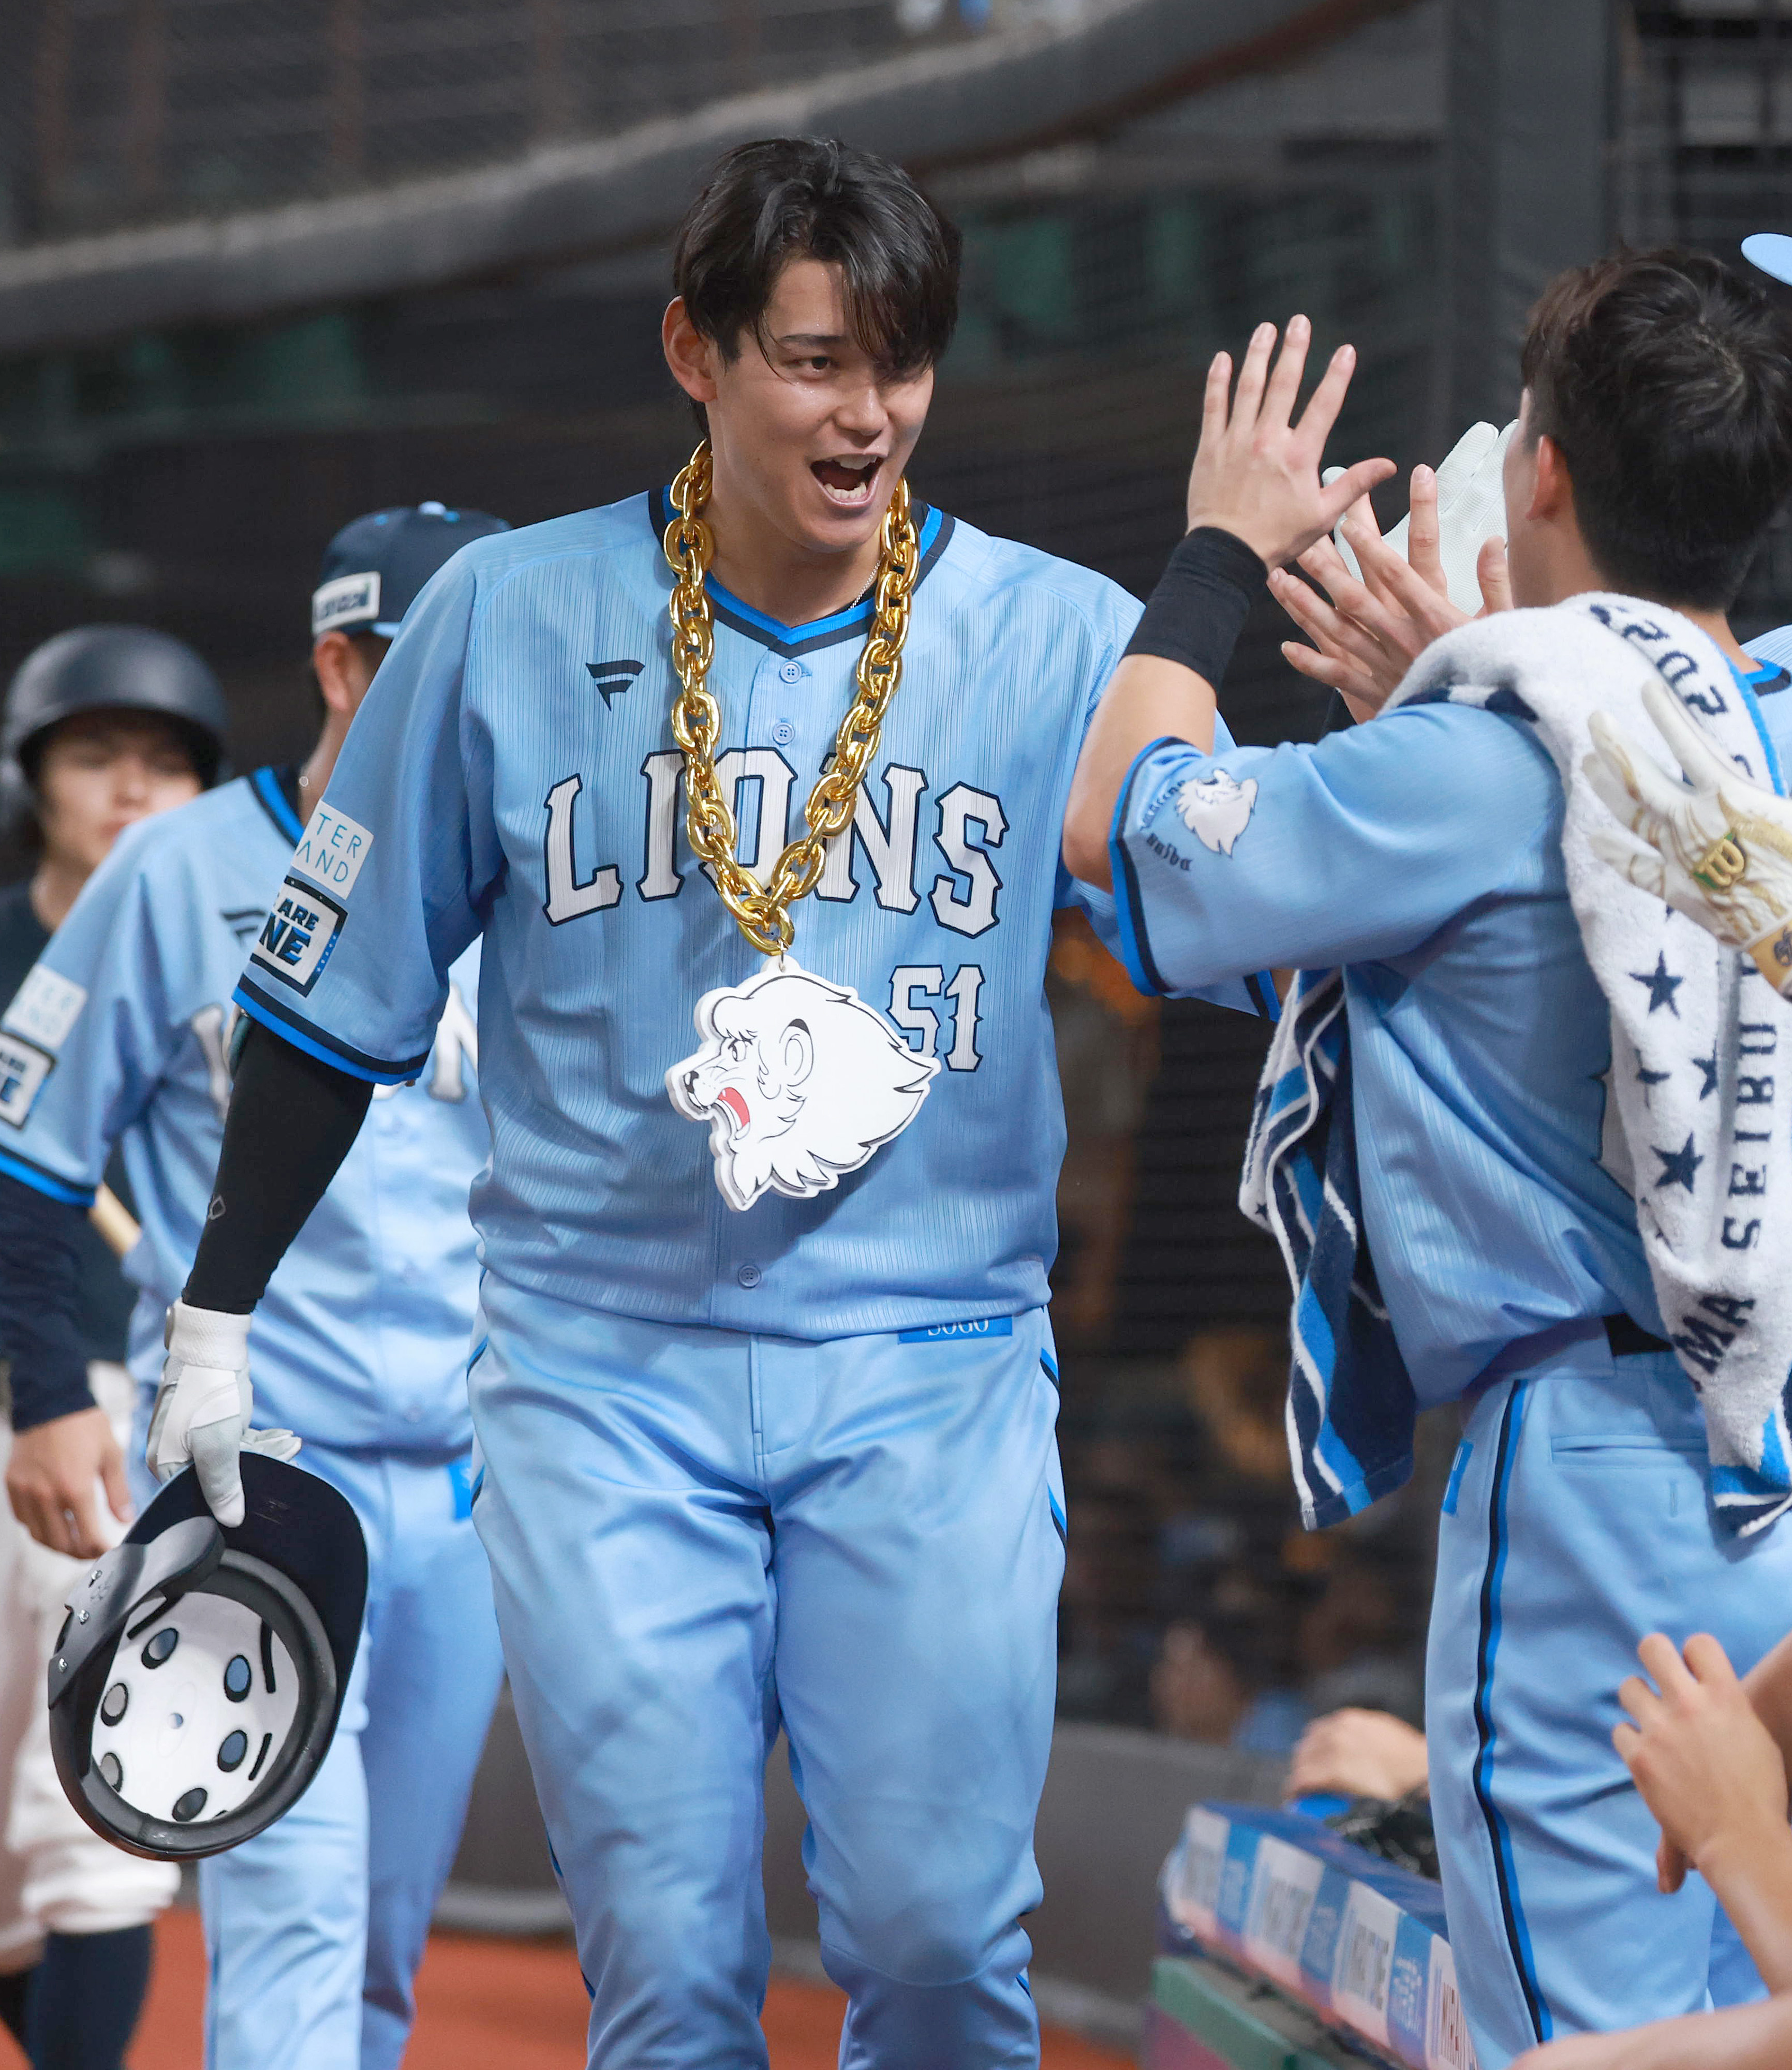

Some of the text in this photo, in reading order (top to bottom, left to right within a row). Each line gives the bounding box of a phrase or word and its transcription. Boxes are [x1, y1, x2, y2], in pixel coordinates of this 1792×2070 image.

[277, 898, 319, 931] ARE
[543, 747, 1010, 939] LIONS
[885, 964, 985, 1072] 51
[1721, 1022, 1776, 1250] SEIBU
